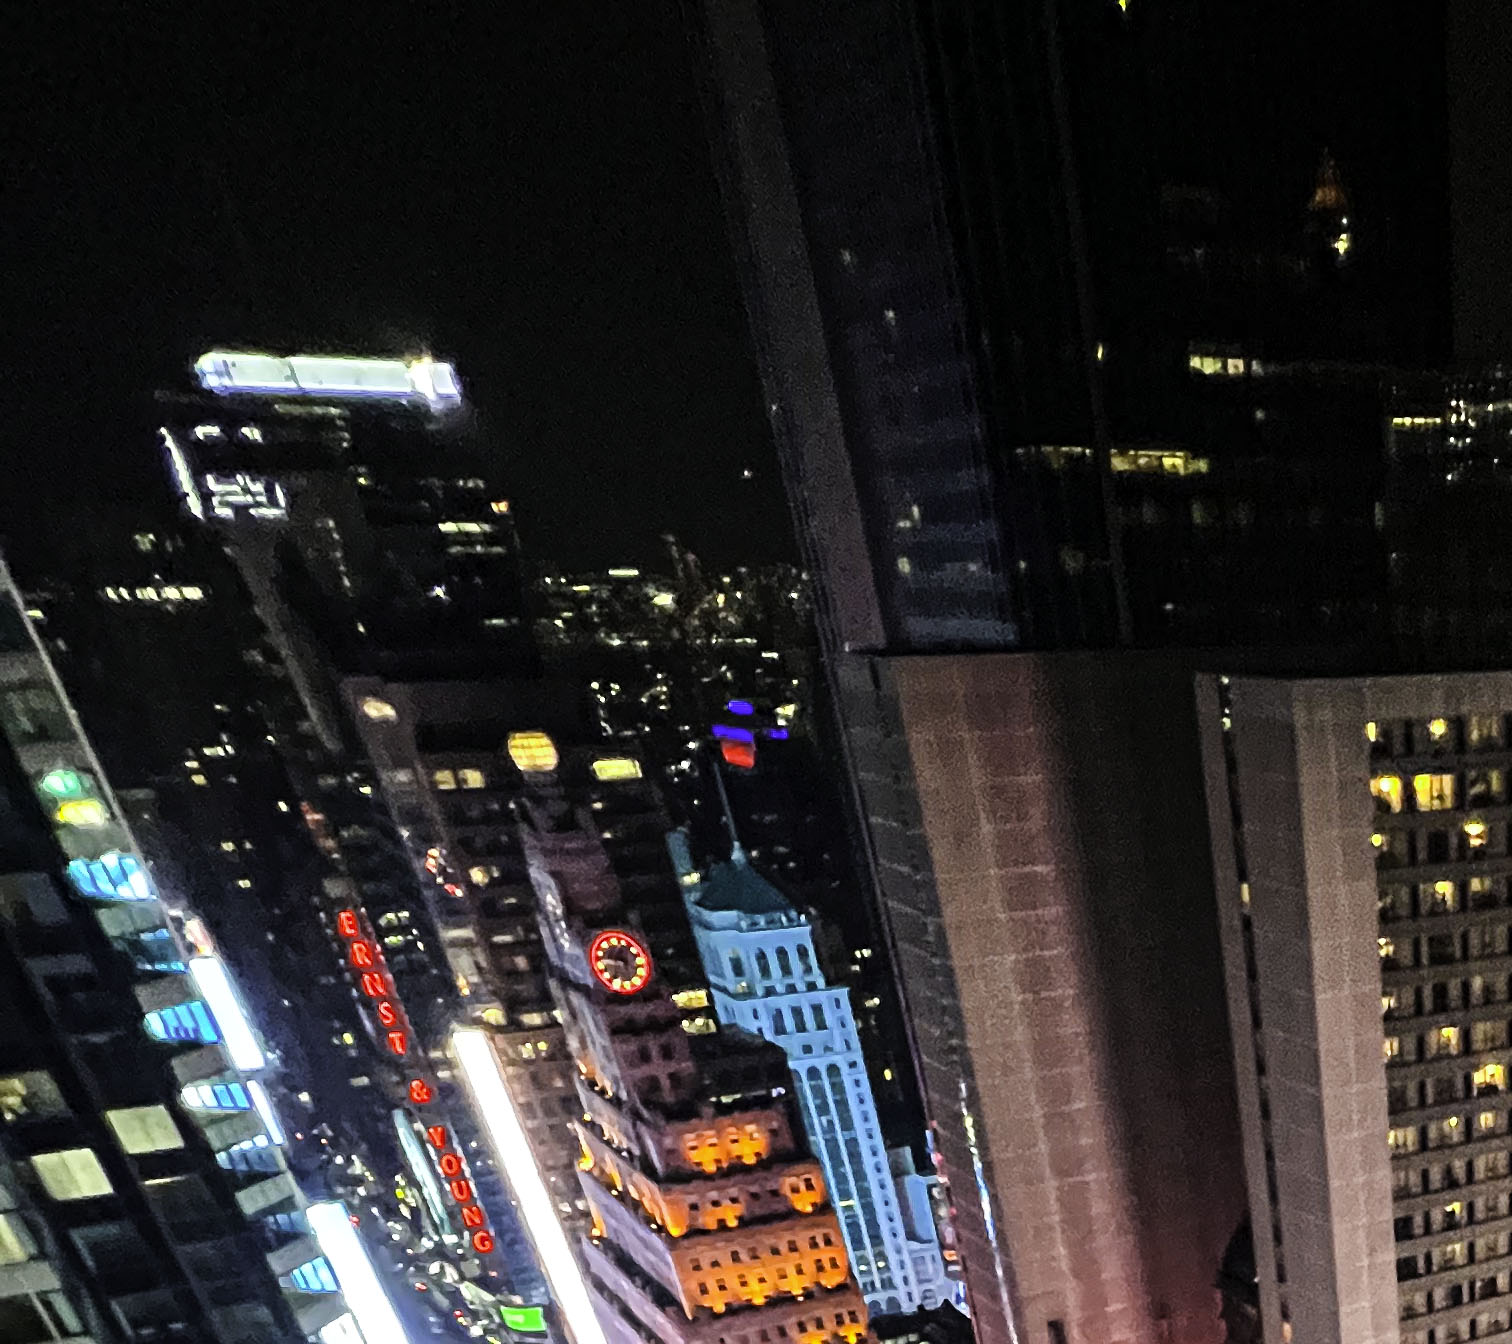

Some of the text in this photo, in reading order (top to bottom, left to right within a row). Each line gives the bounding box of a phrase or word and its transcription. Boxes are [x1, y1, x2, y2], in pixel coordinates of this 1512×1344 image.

[337, 909, 494, 1254] ERNST & YOUNG
